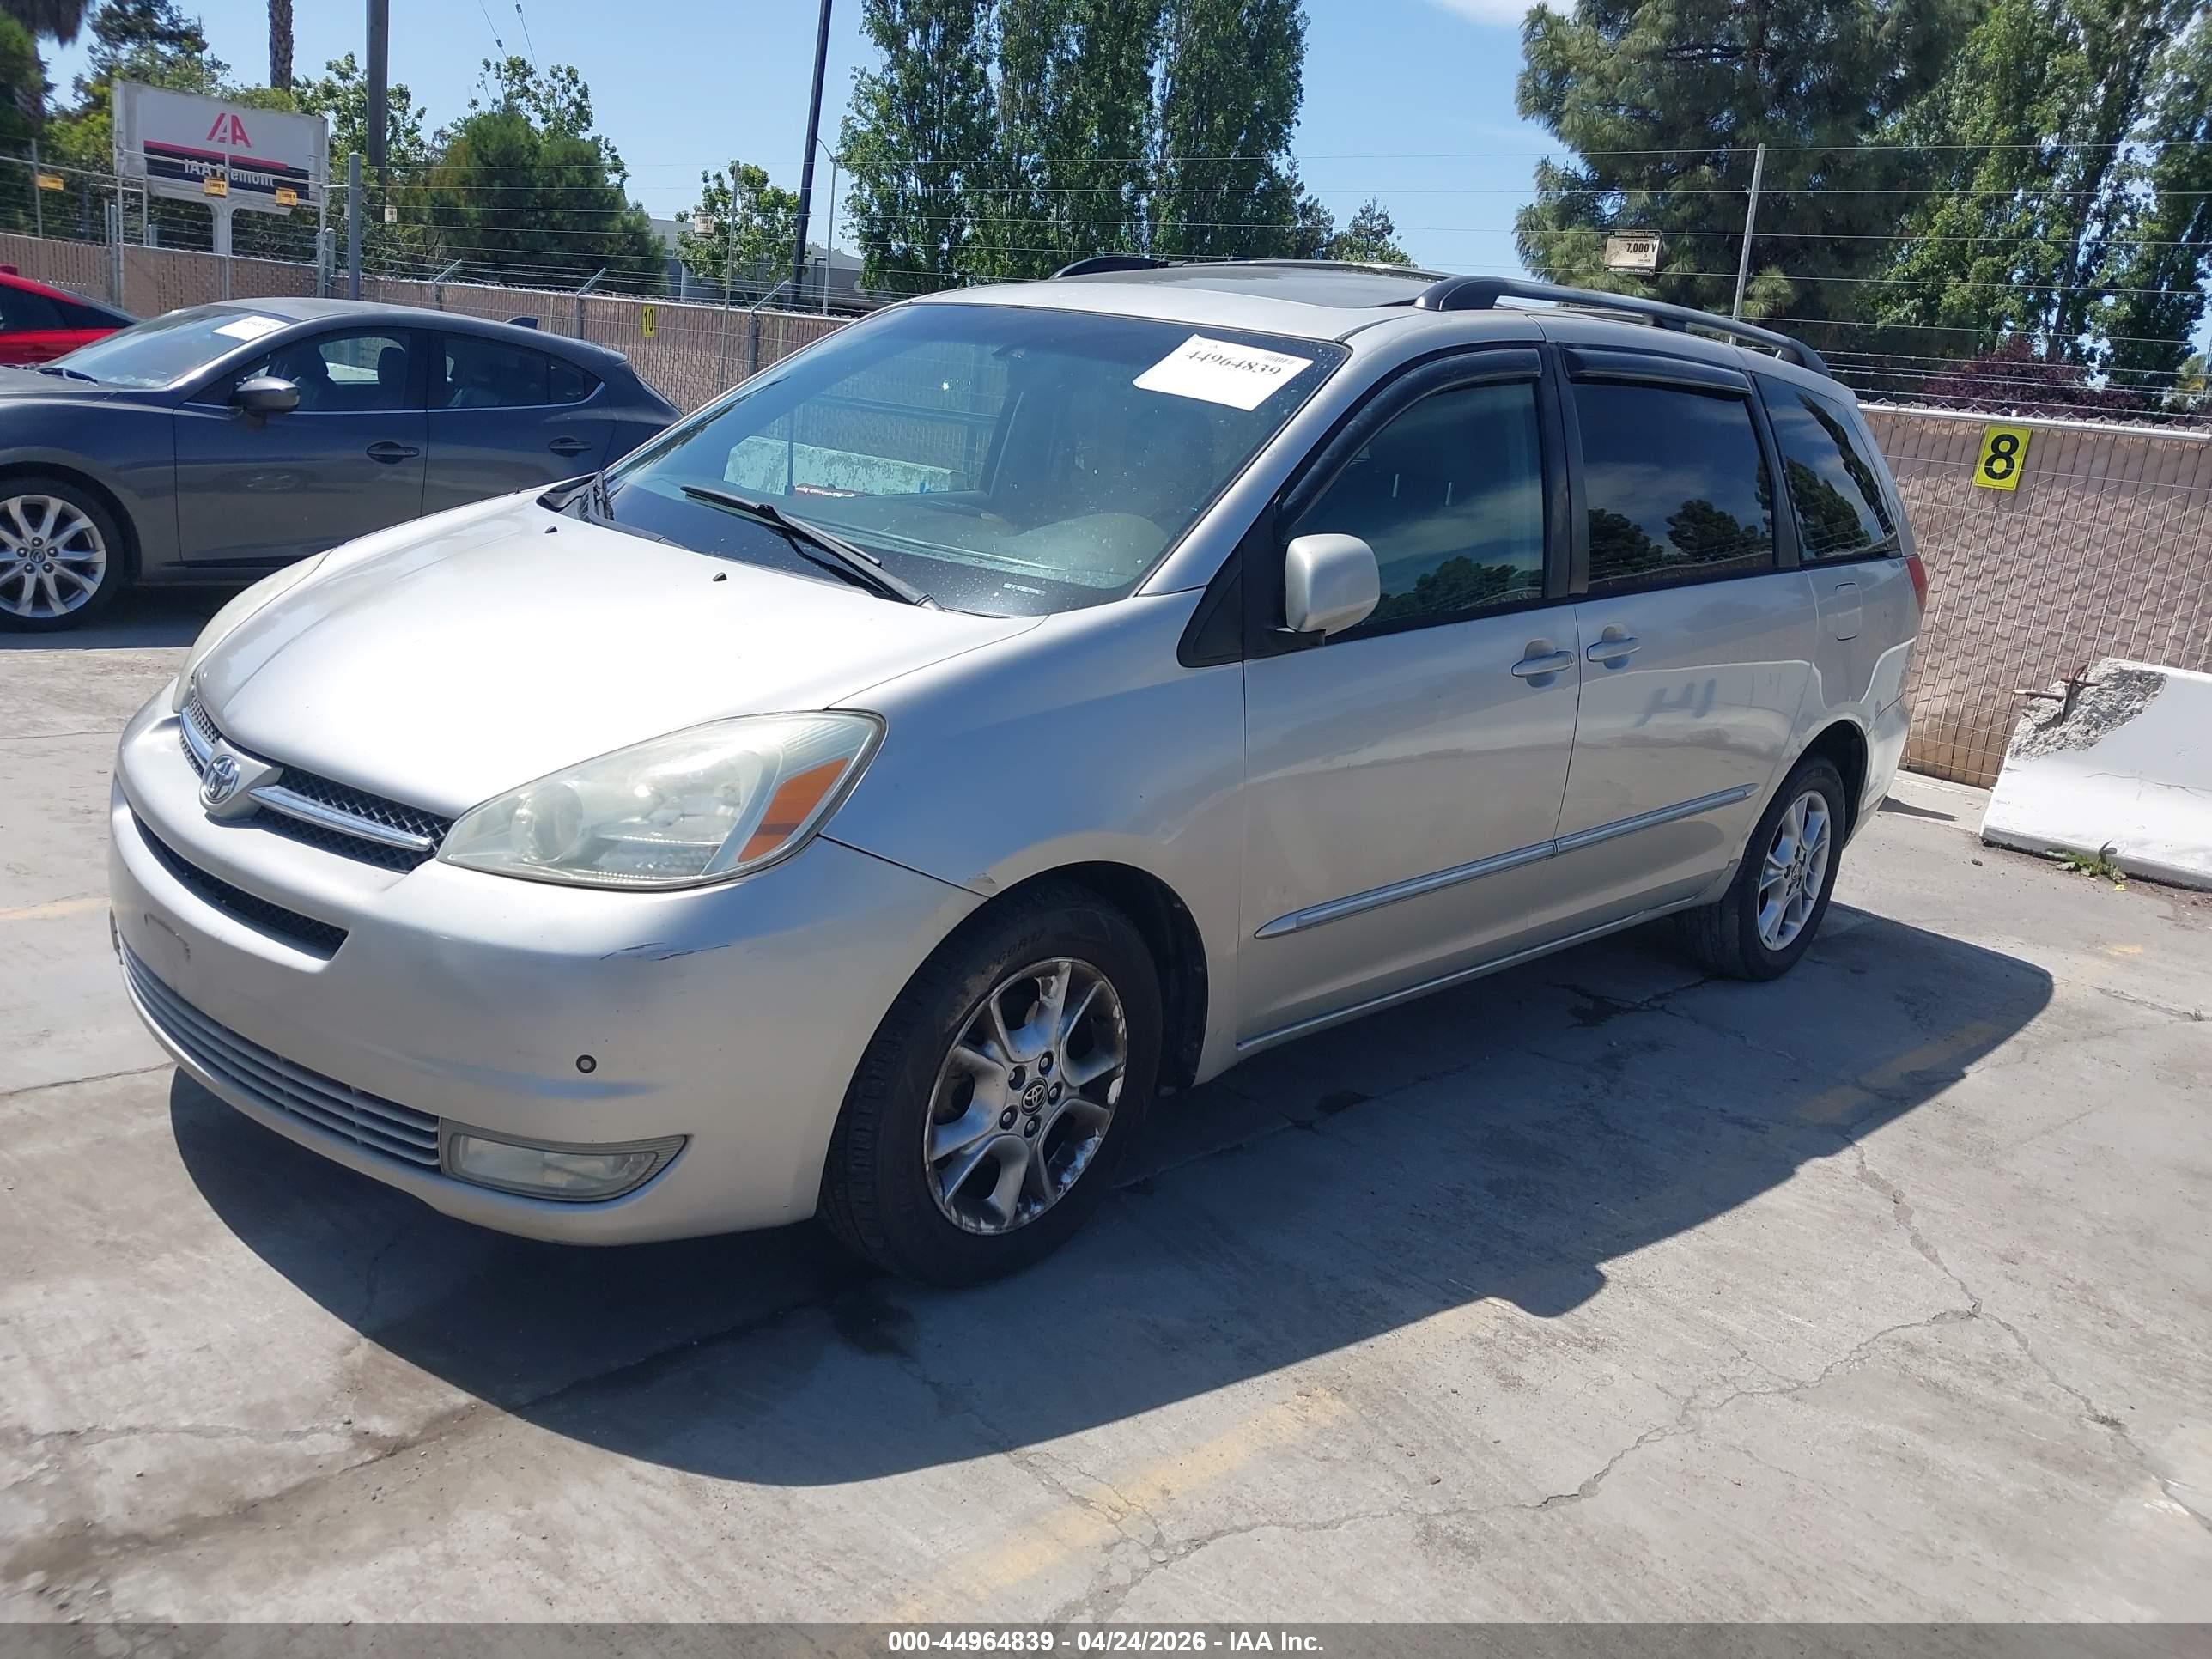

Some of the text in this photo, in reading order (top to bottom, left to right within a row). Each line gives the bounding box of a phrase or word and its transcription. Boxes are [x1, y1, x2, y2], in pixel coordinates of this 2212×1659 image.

[1626, 243, 1650, 254] 7,000
[644, 308, 653, 332] 10
[1185, 350, 1282, 375] 44964839
[1984, 434, 2020, 480] 8
